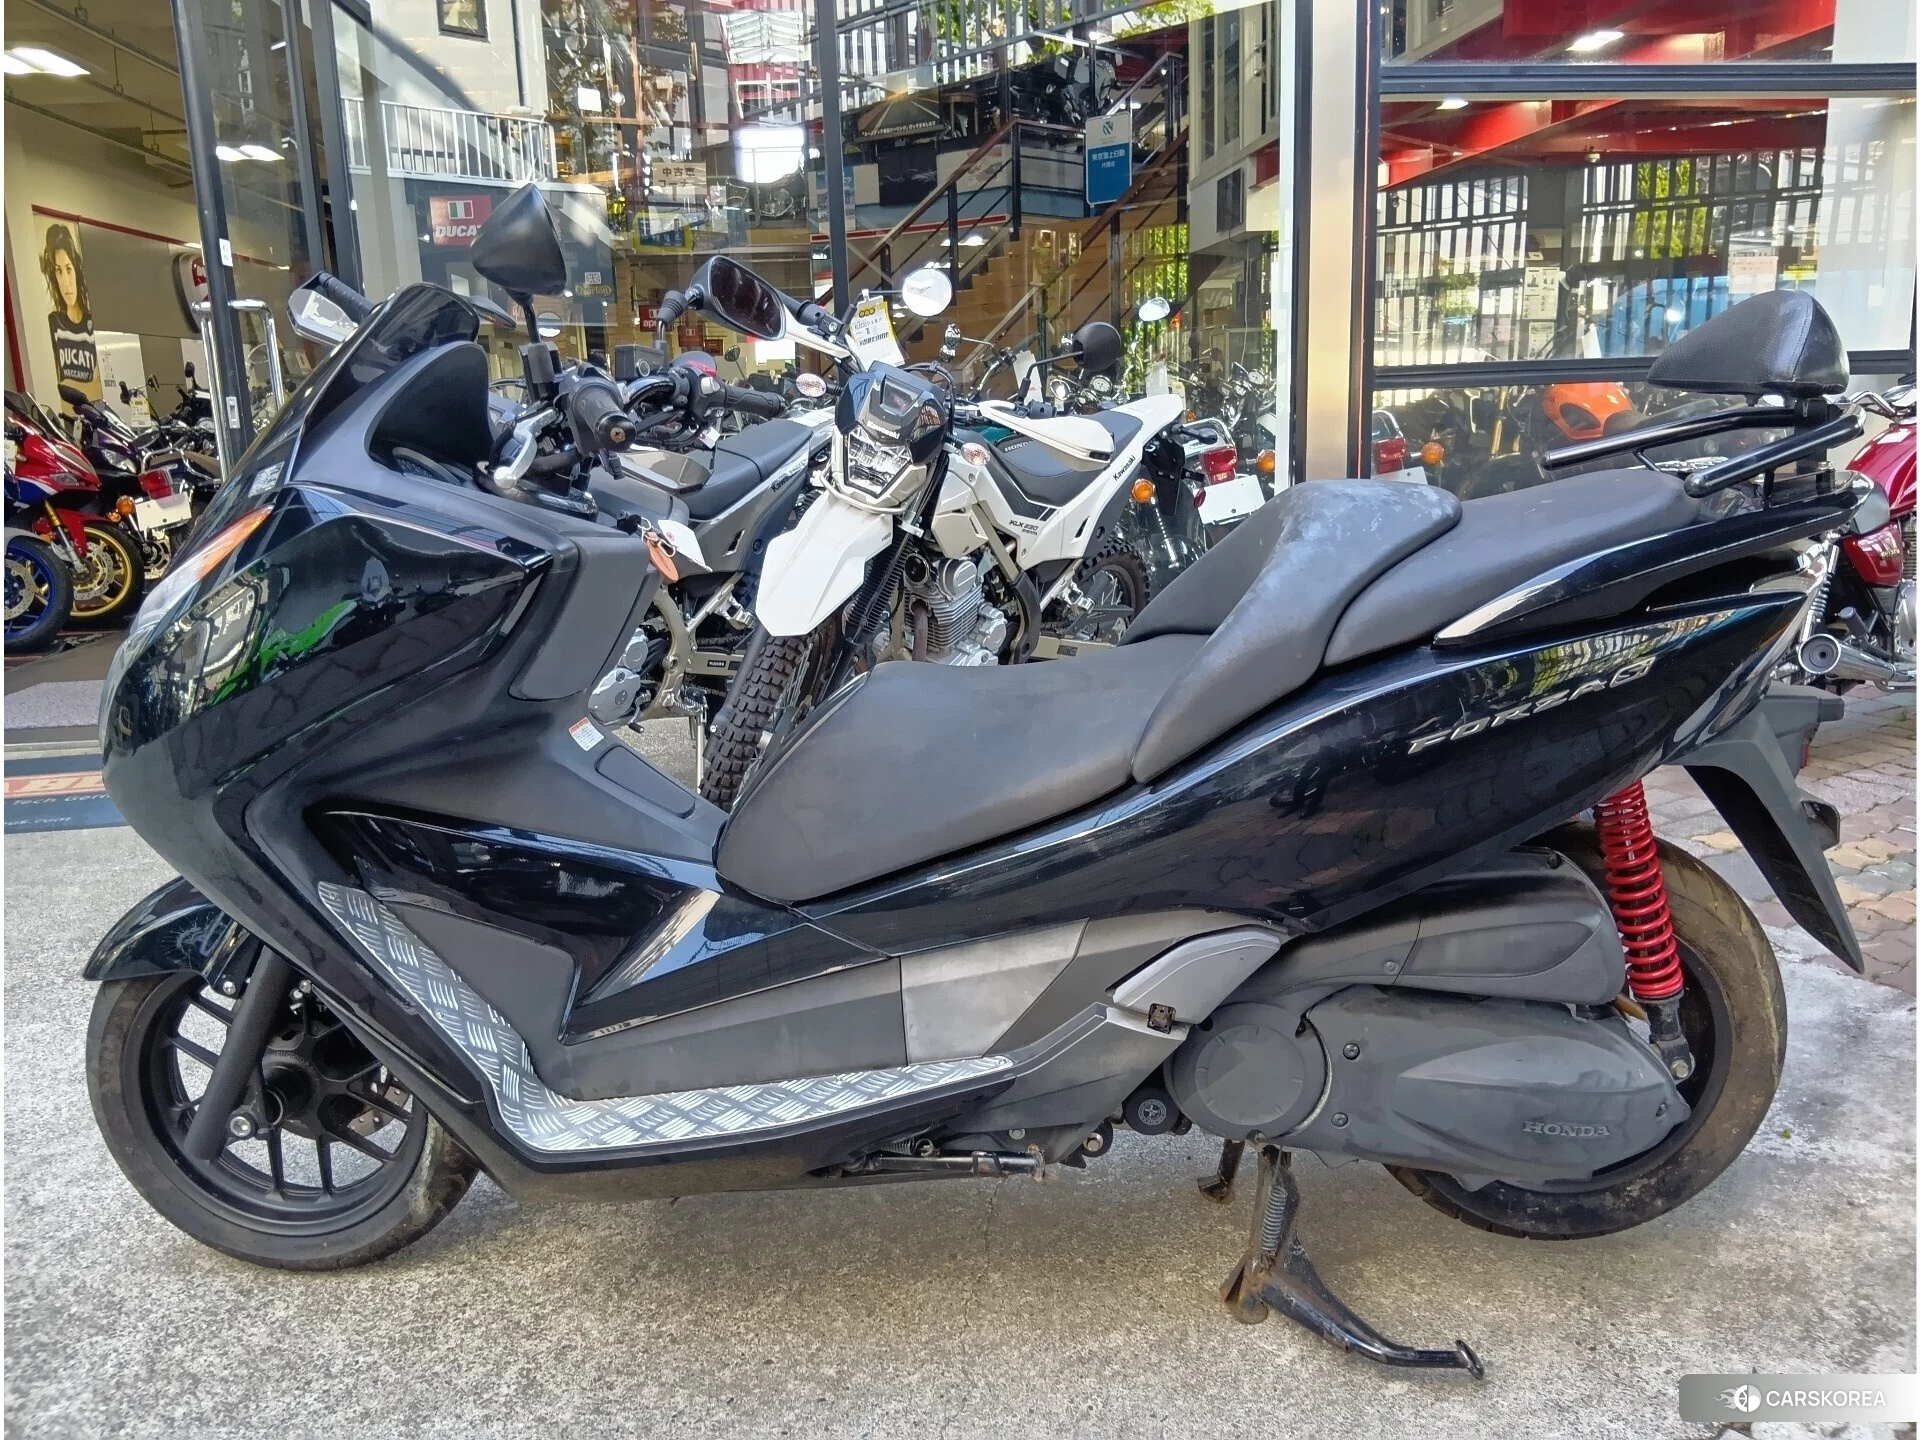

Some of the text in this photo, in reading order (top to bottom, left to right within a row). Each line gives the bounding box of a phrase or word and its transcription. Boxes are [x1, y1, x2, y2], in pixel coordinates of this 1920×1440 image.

[60, 347, 95, 371] DUCATI
[866, 420, 901, 440] Kawasaki
[1112, 454, 1137, 482] Kawasaki
[1008, 519, 1024, 528] KLX
[1407, 679, 1607, 755] FORZA
[1522, 1120, 1611, 1137] HONDA
